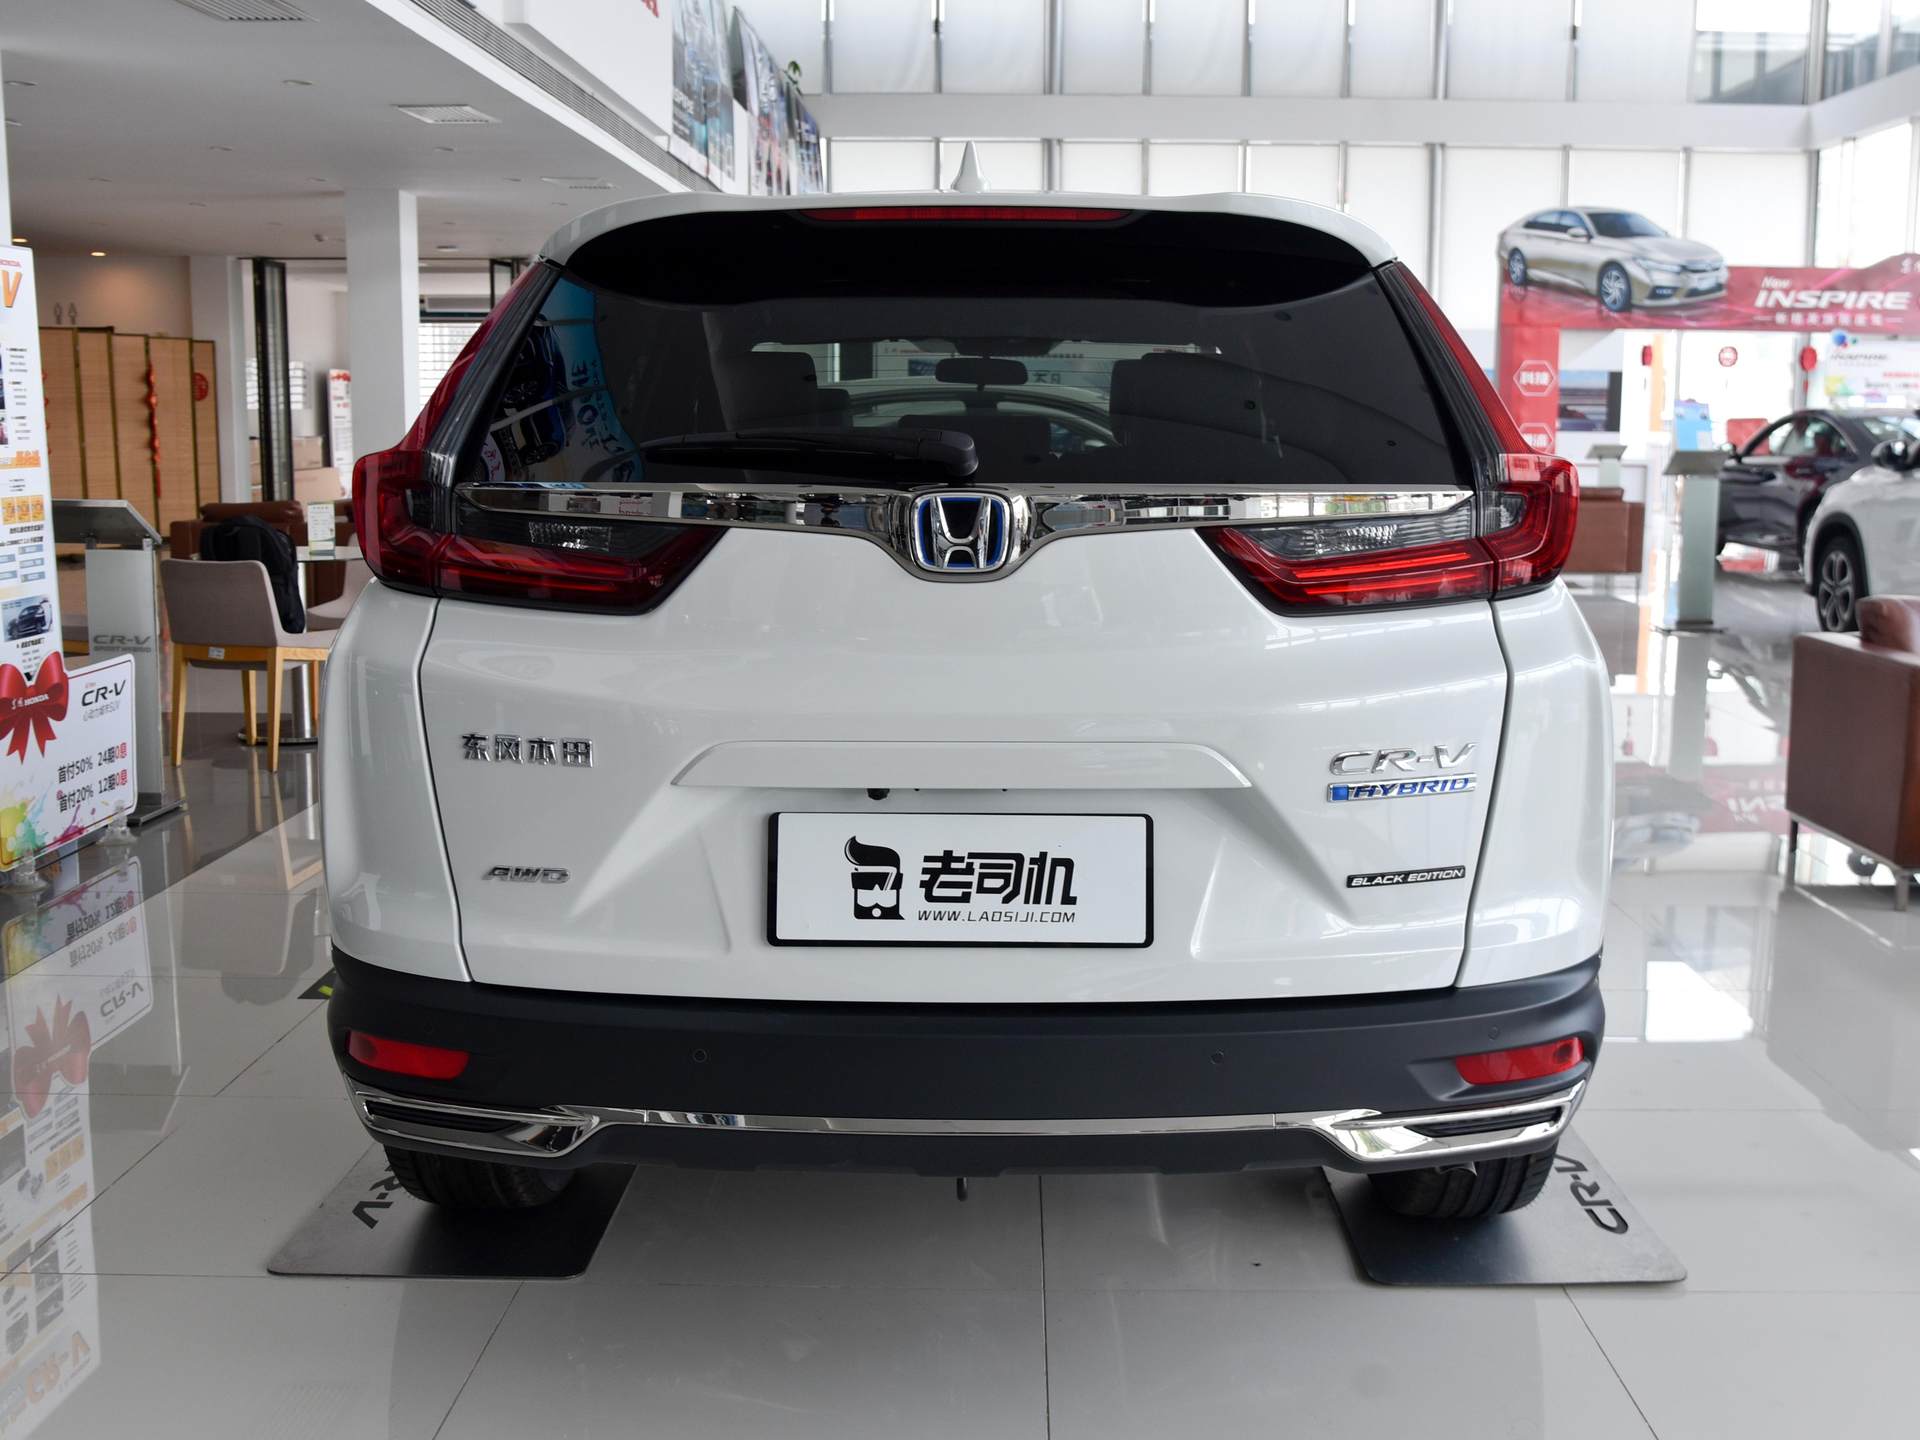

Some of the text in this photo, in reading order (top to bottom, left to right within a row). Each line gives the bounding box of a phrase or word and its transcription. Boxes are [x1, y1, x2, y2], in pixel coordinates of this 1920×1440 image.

[1761, 276, 1791, 289] New
[1754, 290, 1911, 310] INSPIRE
[93, 635, 151, 645] CR-V
[82, 679, 126, 707] CR-V
[462, 733, 593, 768] 东风本田
[1329, 743, 1477, 776] CR-V
[57, 755, 93, 784] 首付50%
[59, 784, 94, 813] 首付20%
[1353, 778, 1469, 798] HYBRID
[482, 865, 570, 884] AWD
[919, 850, 1078, 906] 老司机
[1351, 868, 1464, 887] BLACK EDITION
[918, 909, 1076, 924] WWW.LAOSIJI.COM
[1554, 1153, 1629, 1235] CR-V
